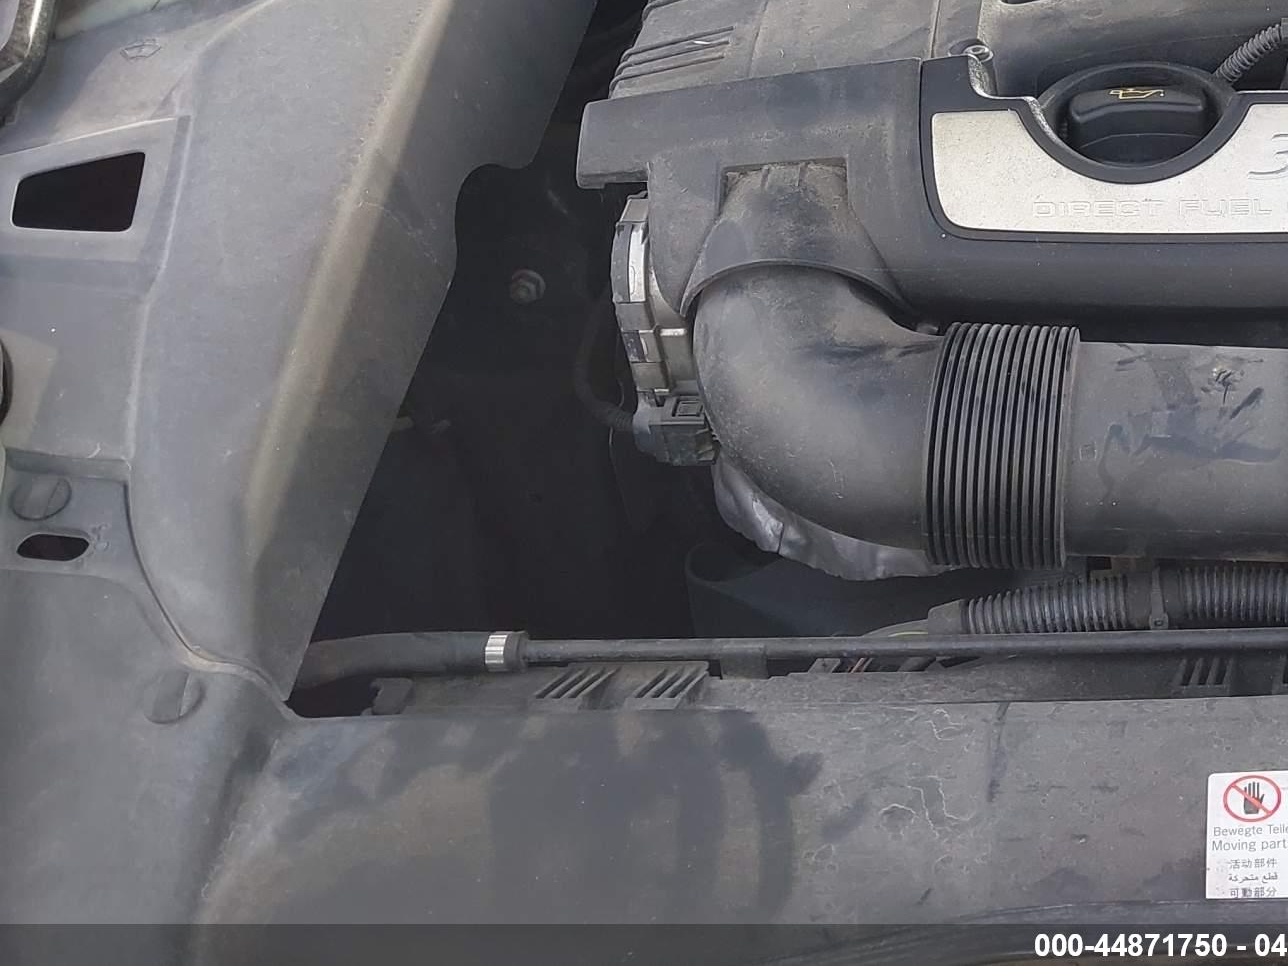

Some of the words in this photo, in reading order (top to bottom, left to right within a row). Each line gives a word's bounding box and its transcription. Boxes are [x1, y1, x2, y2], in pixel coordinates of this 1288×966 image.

[1033, 200, 1164, 217] DIRECT
[1178, 198, 1273, 216] FUEL
[1213, 825, 1263, 837] Bewegte
[1211, 839, 1257, 852] Moving
[1229, 858, 1277, 869] 活动部件
[1228, 874, 1259, 883] متحركة
[1262, 872, 1278, 884] قطع
